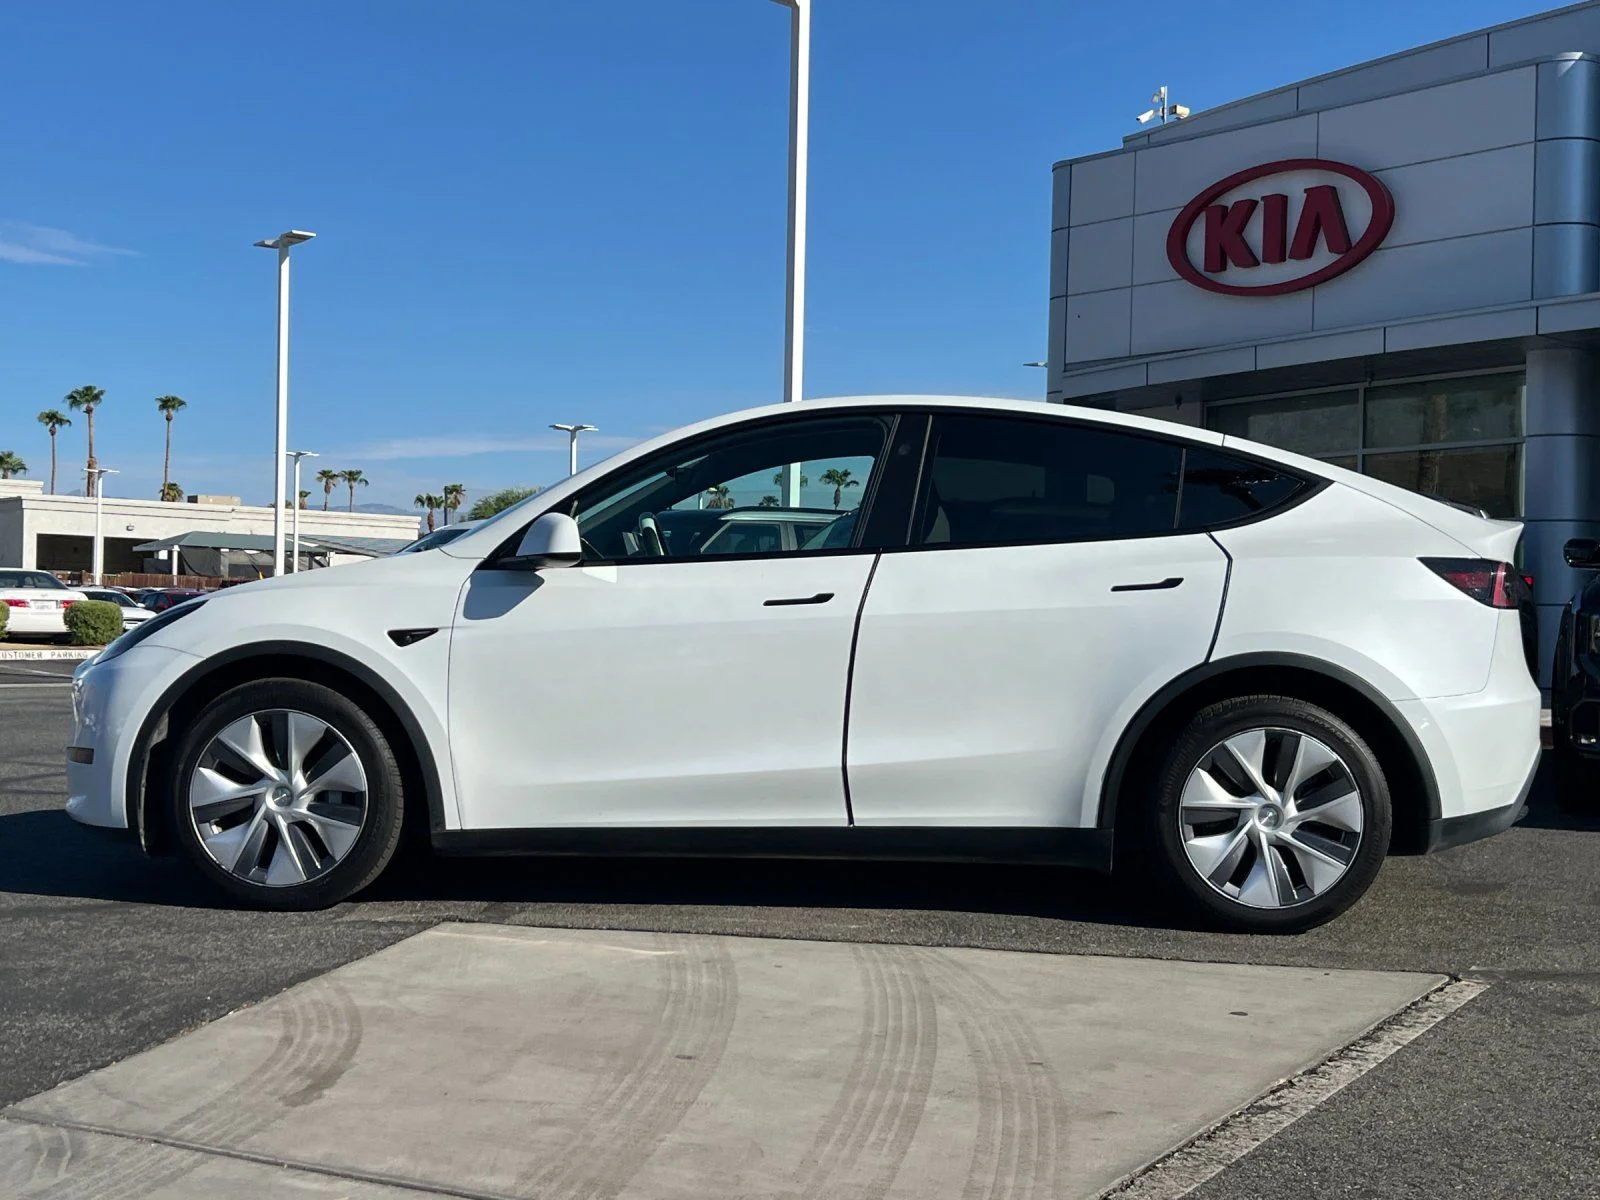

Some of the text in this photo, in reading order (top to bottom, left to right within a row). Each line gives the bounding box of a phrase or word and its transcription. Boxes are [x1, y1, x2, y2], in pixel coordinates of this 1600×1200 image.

[1203, 184, 1352, 273] KIA
[0, 650, 88, 659] USTOMER PARKING
